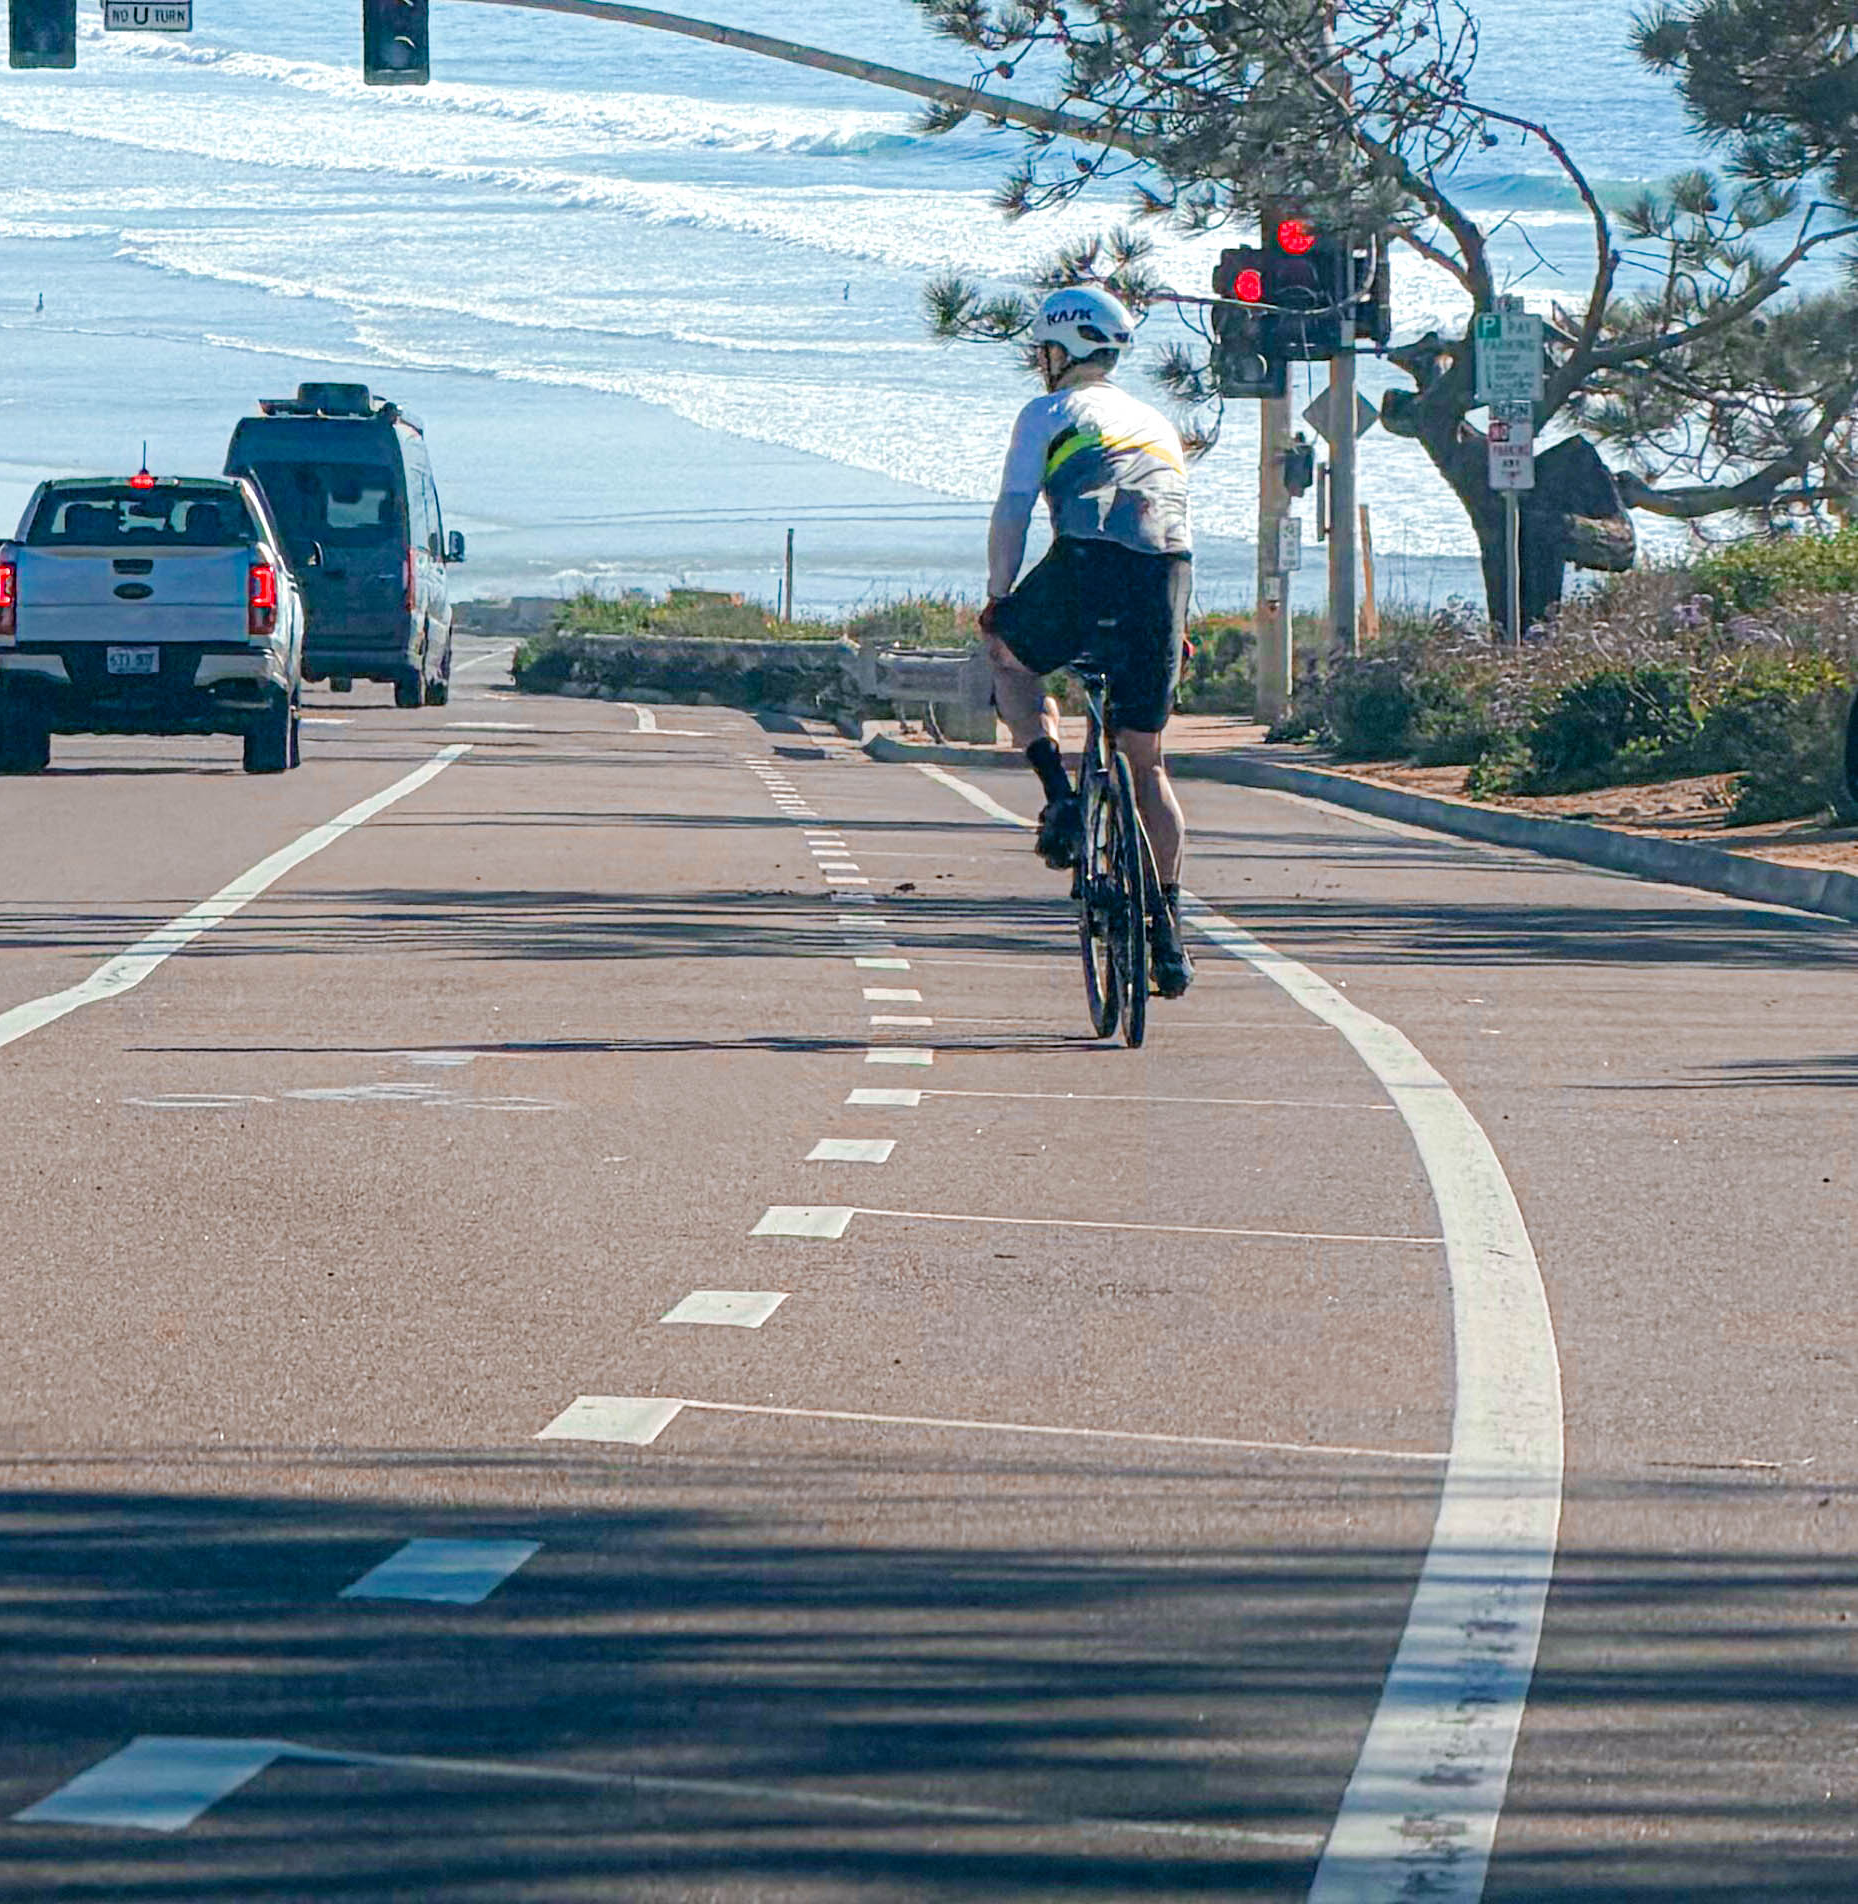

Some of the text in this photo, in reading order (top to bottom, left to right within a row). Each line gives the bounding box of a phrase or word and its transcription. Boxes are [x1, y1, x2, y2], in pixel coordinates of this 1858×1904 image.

[112, 6, 185, 25] NO U TURN
[1482, 316, 1532, 337] P PAY
